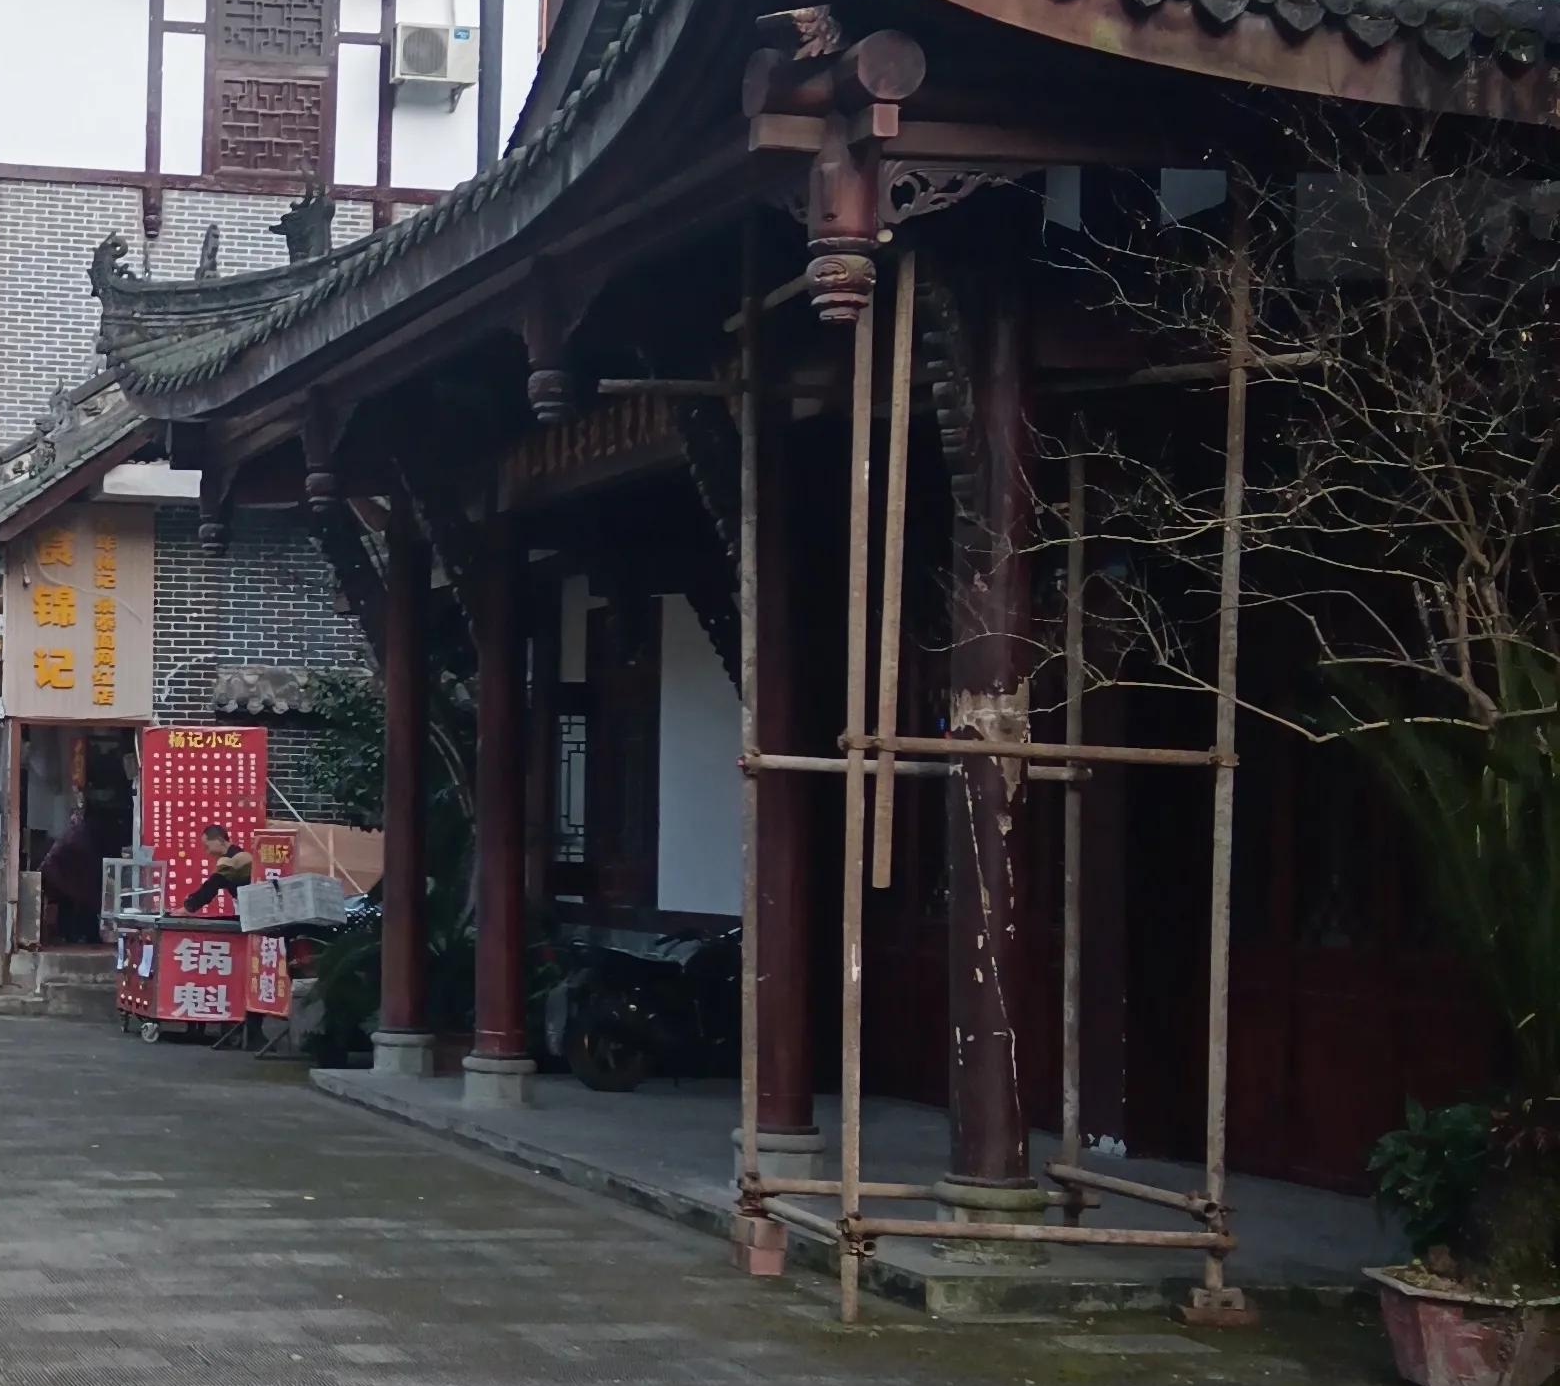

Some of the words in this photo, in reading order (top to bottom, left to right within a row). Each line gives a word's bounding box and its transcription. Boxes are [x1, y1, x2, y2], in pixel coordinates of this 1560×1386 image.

[168, 731, 242, 748] 杨记小吃
[171, 938, 233, 1020] 锅魁
